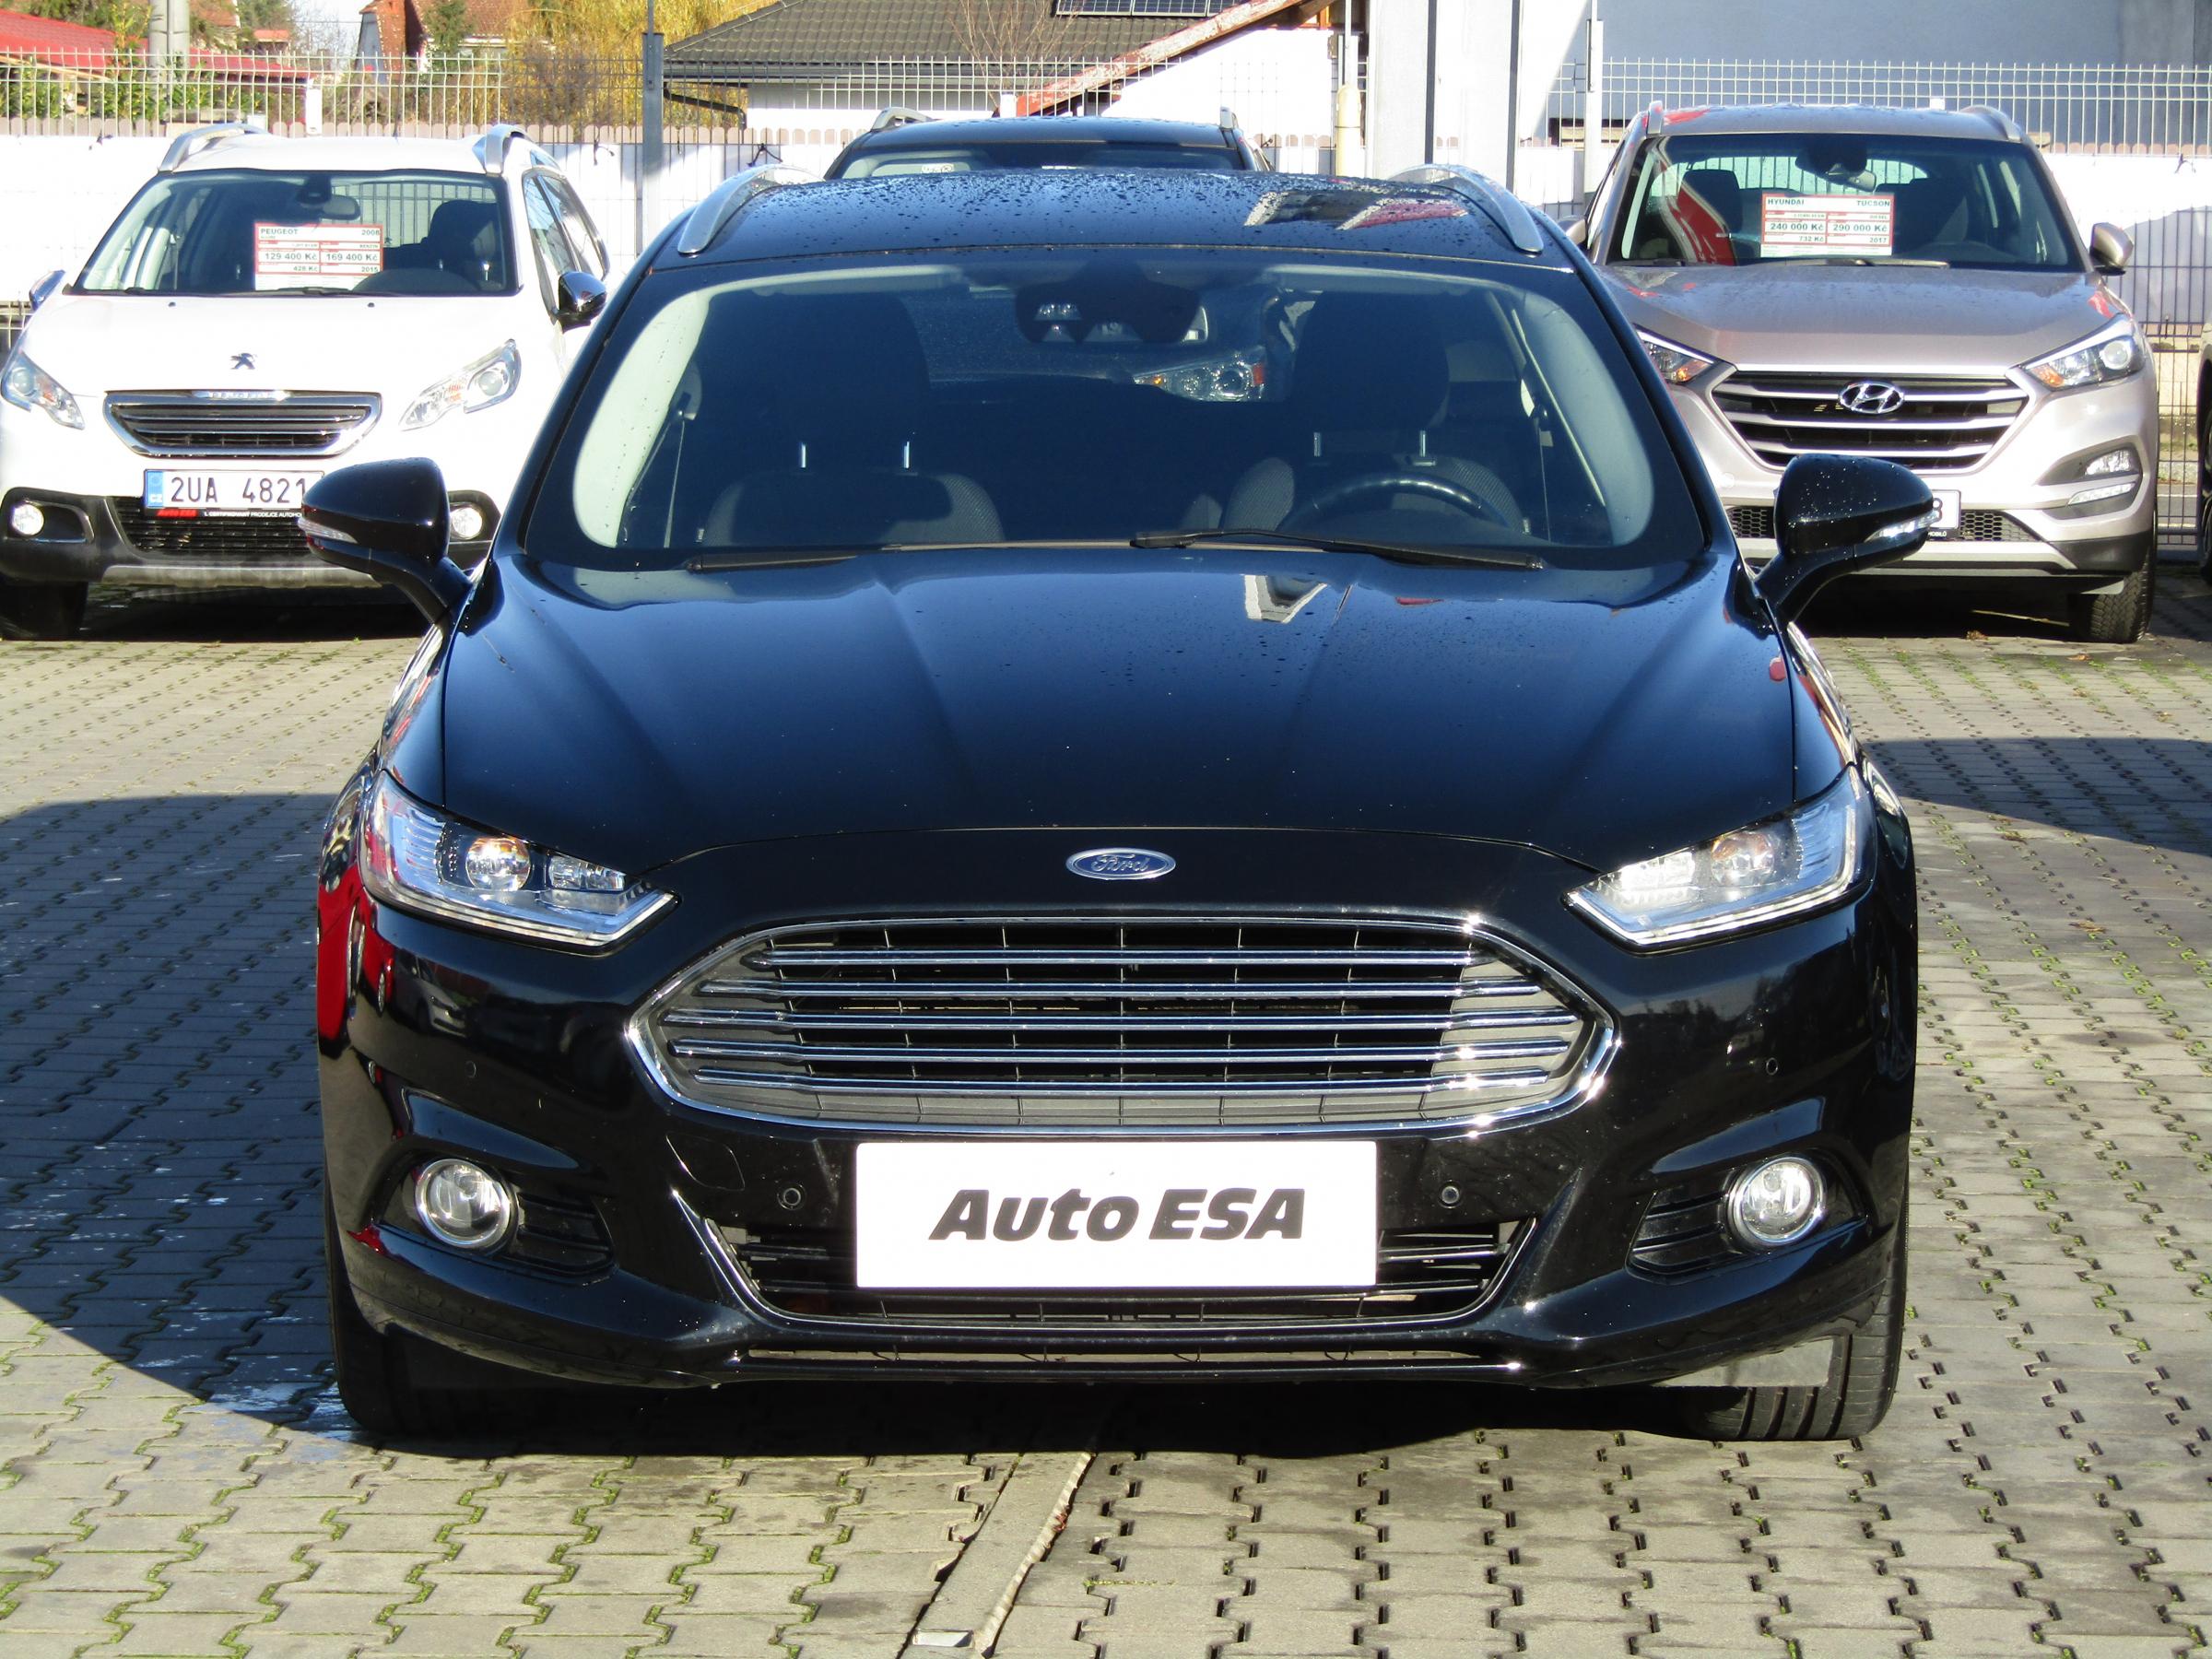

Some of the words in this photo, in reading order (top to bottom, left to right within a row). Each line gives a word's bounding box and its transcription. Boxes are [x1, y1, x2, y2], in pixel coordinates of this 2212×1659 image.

[1770, 222, 1788, 230] 240
[1811, 222, 1824, 231] Kč
[1875, 224, 1888, 232] Kč
[305, 253, 318, 261] Kč
[171, 477, 218, 503] 2UA
[242, 477, 306, 504] 4821
[150, 493, 163, 503] CZ
[1090, 853, 1151, 872] Ford
[928, 1188, 1139, 1241] Auto
[1148, 1188, 1305, 1241] ESA
